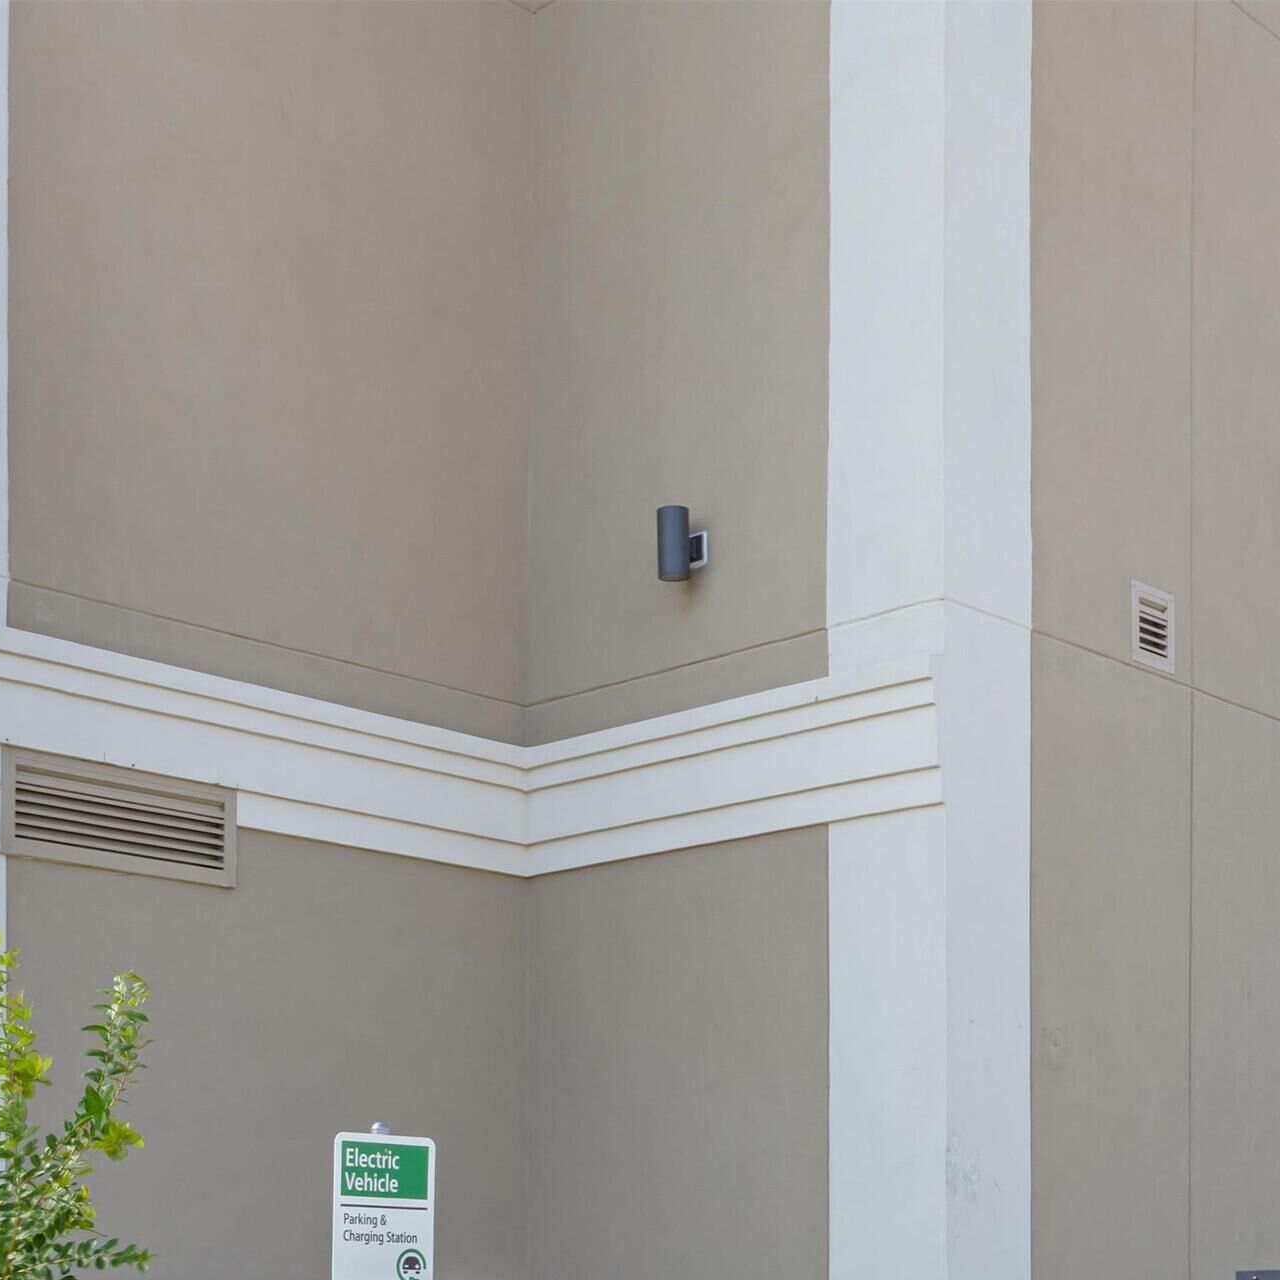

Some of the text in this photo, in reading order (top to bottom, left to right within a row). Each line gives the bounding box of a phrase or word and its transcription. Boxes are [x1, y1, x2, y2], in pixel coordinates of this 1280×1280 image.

[345, 1148, 400, 1169] Electric
[345, 1173, 398, 1192] Vehicle
[343, 1213, 387, 1228] Parking &
[343, 1230, 417, 1245] Charging Station
